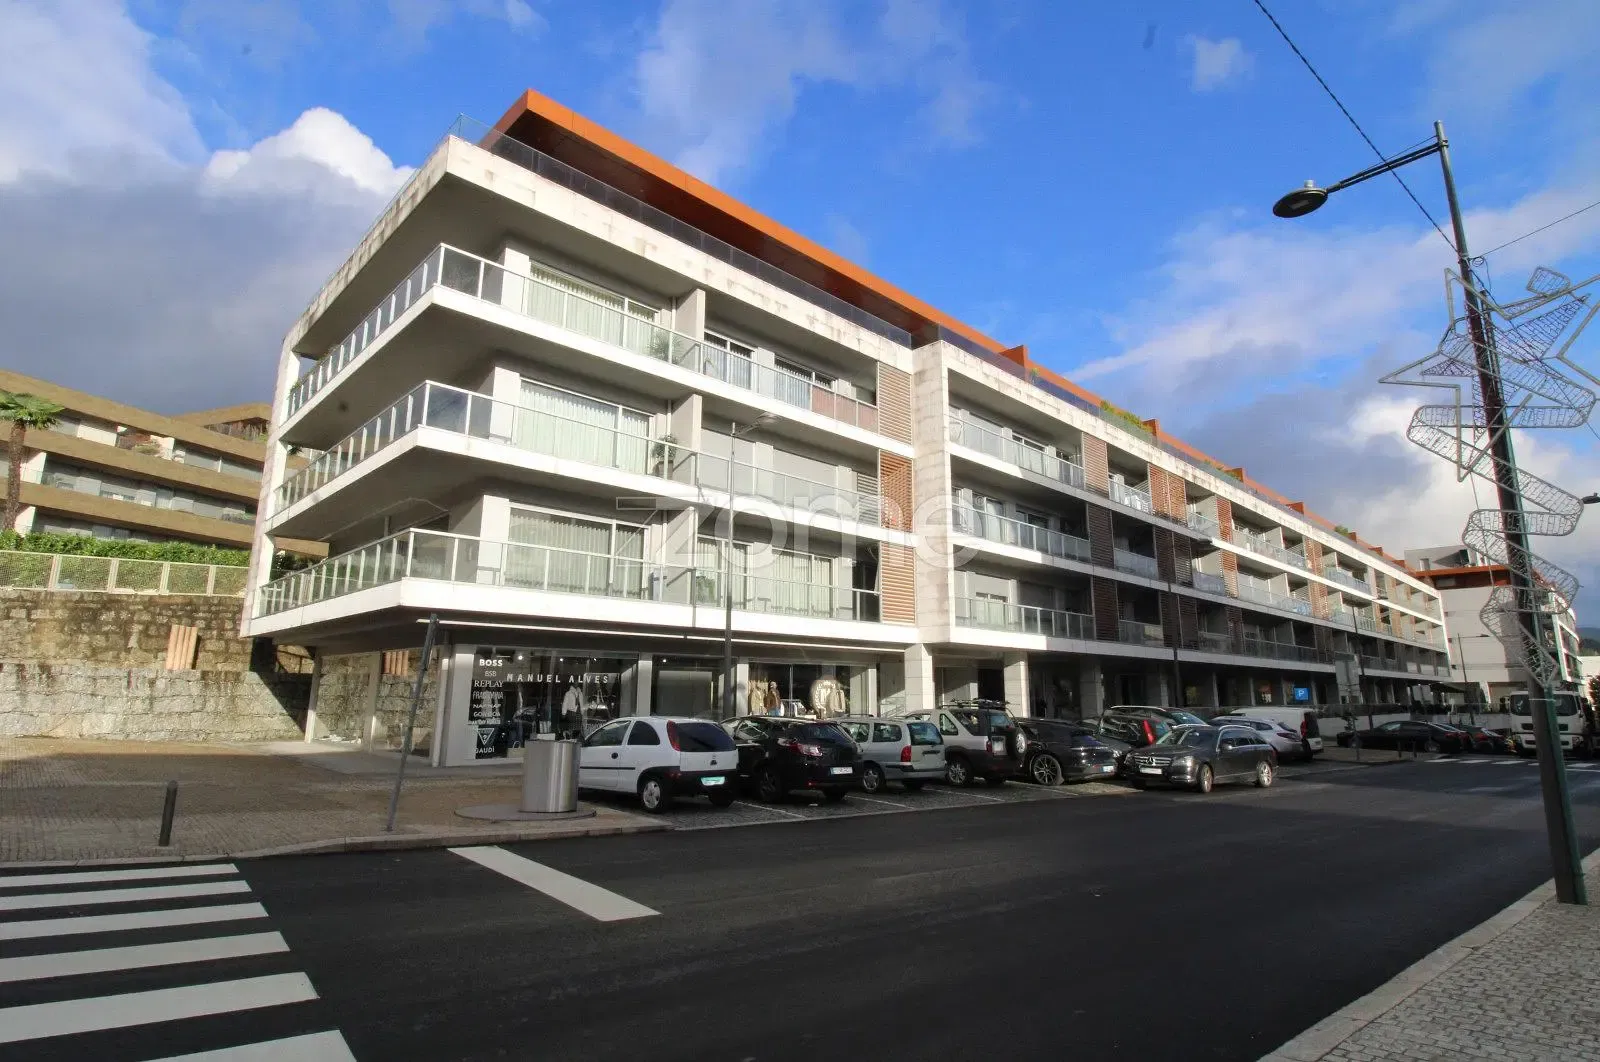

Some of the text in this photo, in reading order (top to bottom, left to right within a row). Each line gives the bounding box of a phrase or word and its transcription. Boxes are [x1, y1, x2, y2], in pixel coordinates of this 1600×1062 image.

[479, 659, 503, 667] BOSS
[506, 673, 609, 684] MANUEL ALVES
[474, 680, 504, 688] REPLAY
